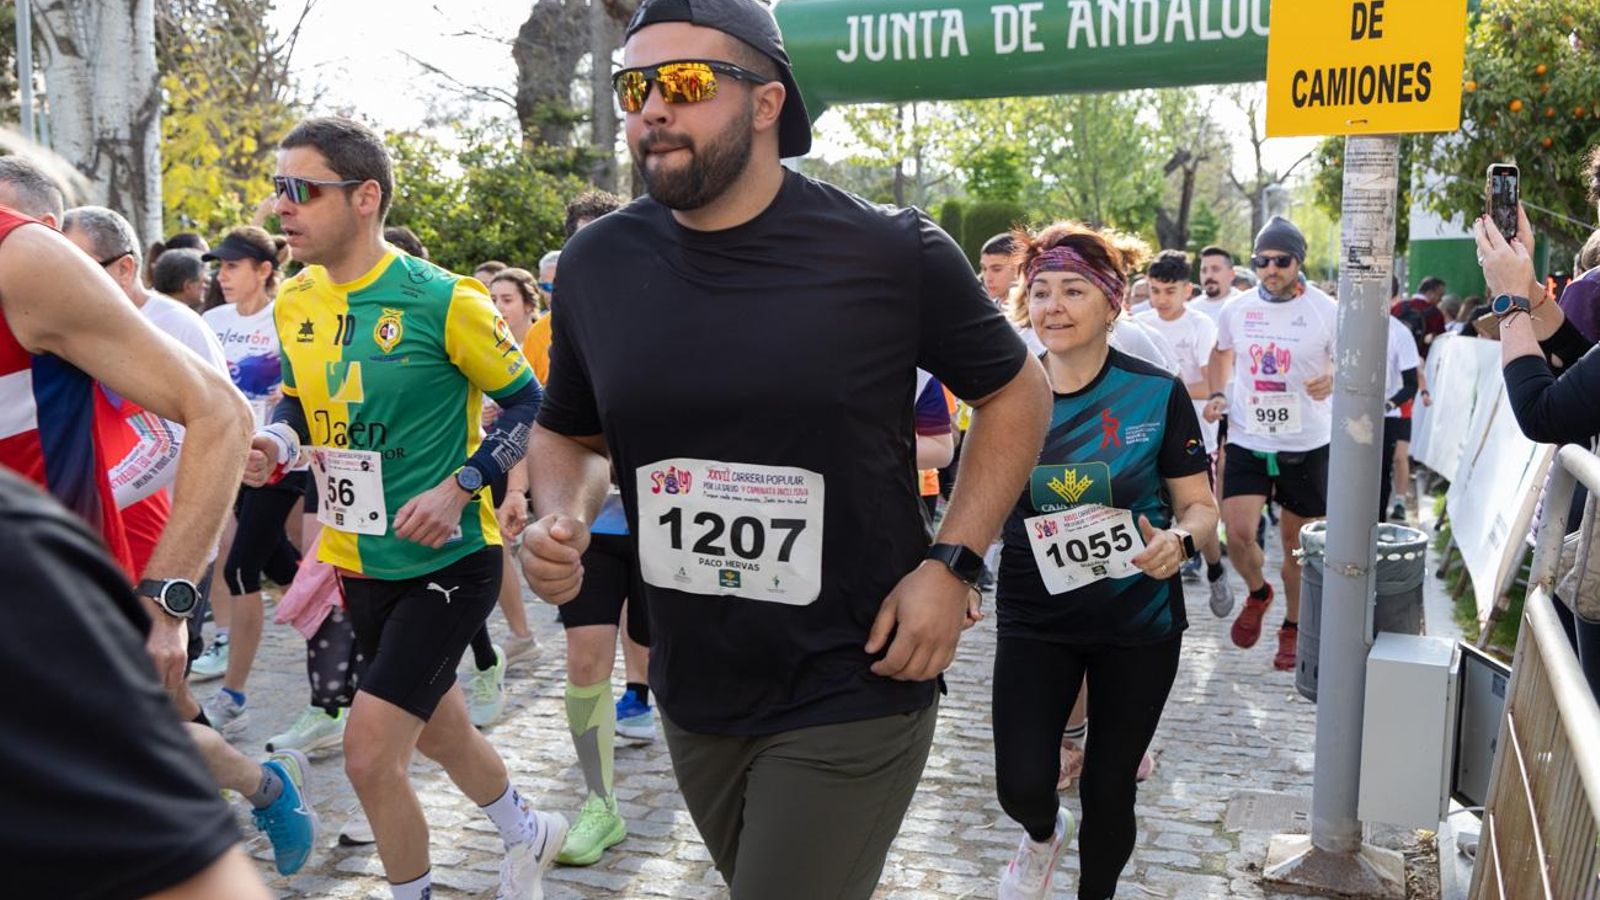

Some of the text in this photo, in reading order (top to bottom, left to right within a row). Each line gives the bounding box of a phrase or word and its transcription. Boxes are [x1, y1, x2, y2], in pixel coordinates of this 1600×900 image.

[835, 9, 969, 64] JUNTA
[992, 2, 1044, 55] DE
[1350, 0, 1384, 41] DE
[1291, 61, 1432, 109] CAMIONES
[314, 409, 387, 448] Jaén
[1255, 407, 1289, 423] 998
[327, 475, 355, 507] 56
[732, 471, 765, 484] CARRERA
[766, 474, 804, 486] POPULAR
[659, 506, 807, 563] 1207
[1046, 523, 1133, 568] 1055
[698, 557, 760, 572] PACO HERVAS
